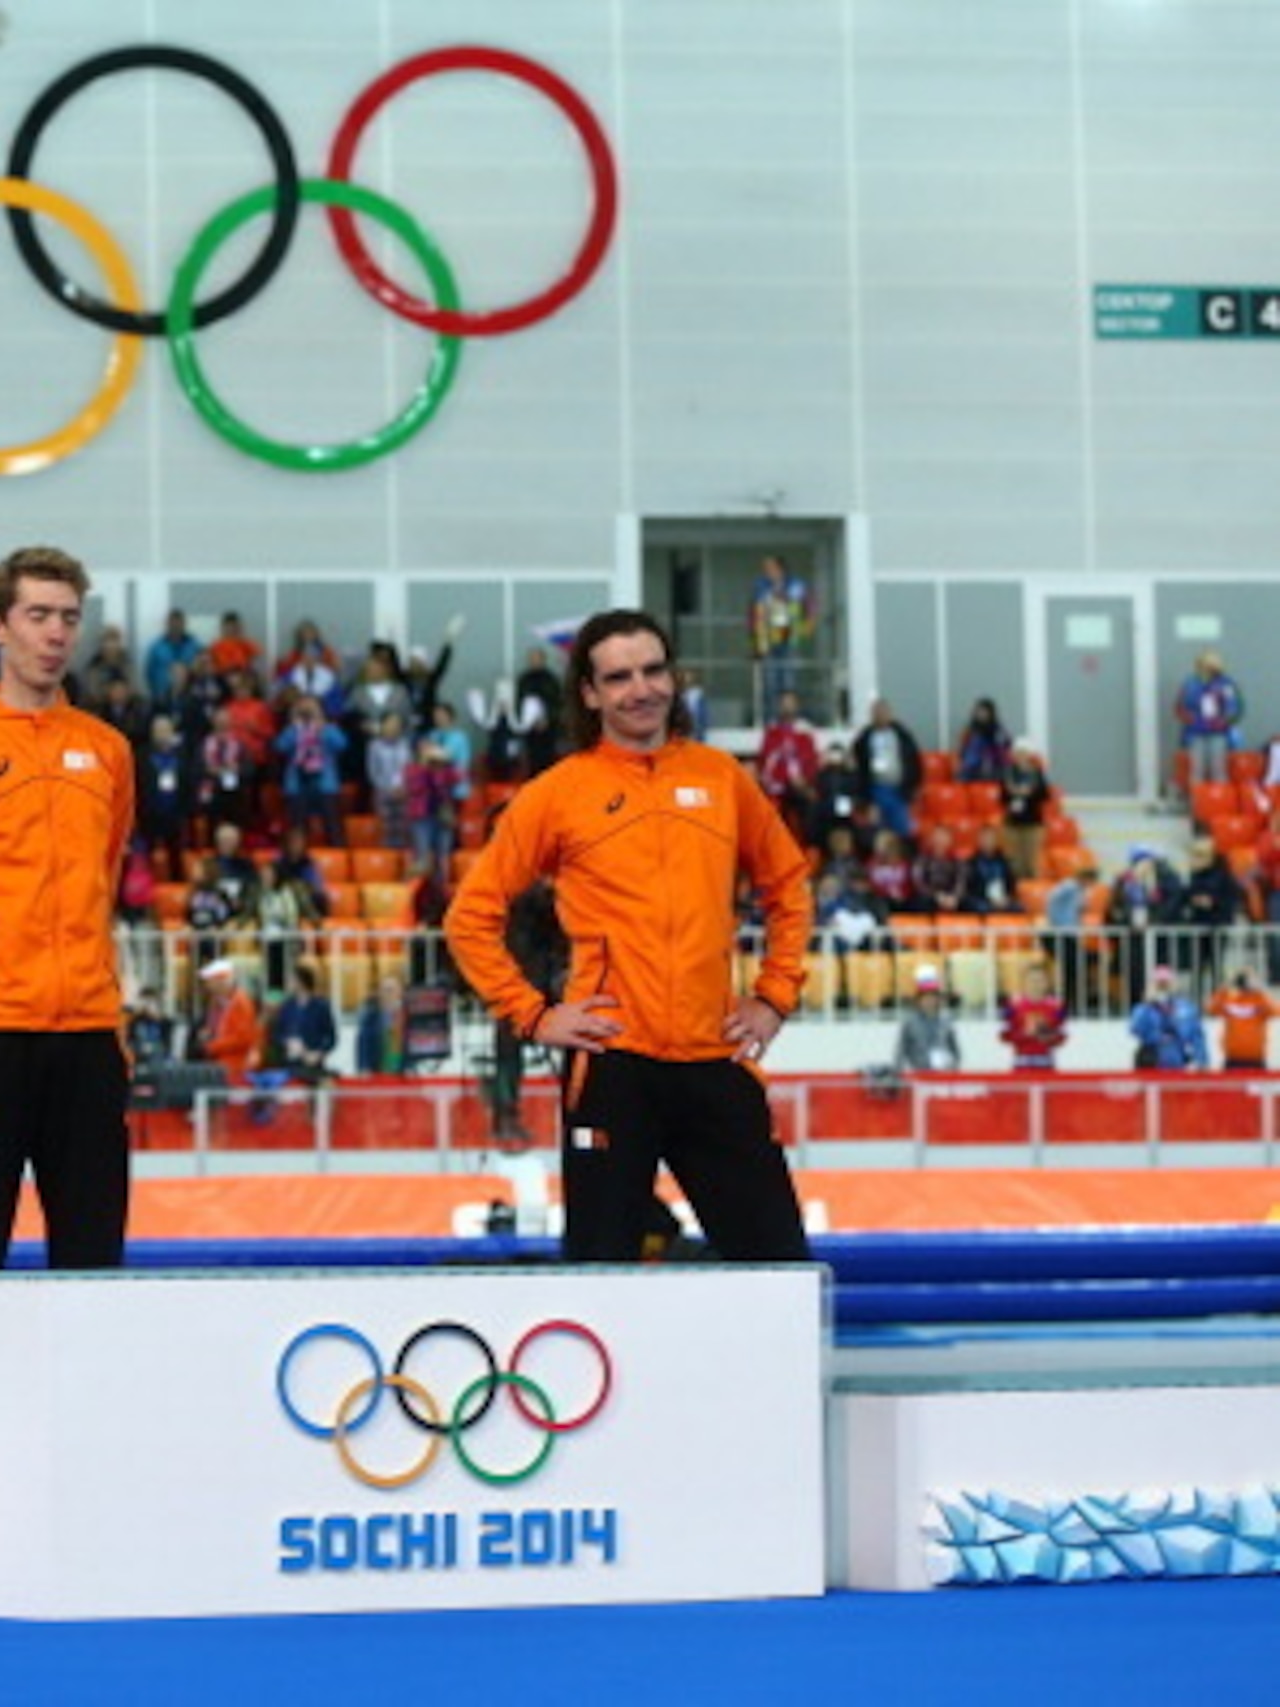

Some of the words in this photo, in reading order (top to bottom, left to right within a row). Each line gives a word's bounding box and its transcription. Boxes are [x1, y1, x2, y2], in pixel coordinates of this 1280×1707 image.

[1206, 295, 1236, 331] C
[279, 1513, 458, 1574] SOCHI
[478, 1509, 617, 1568] 2014
